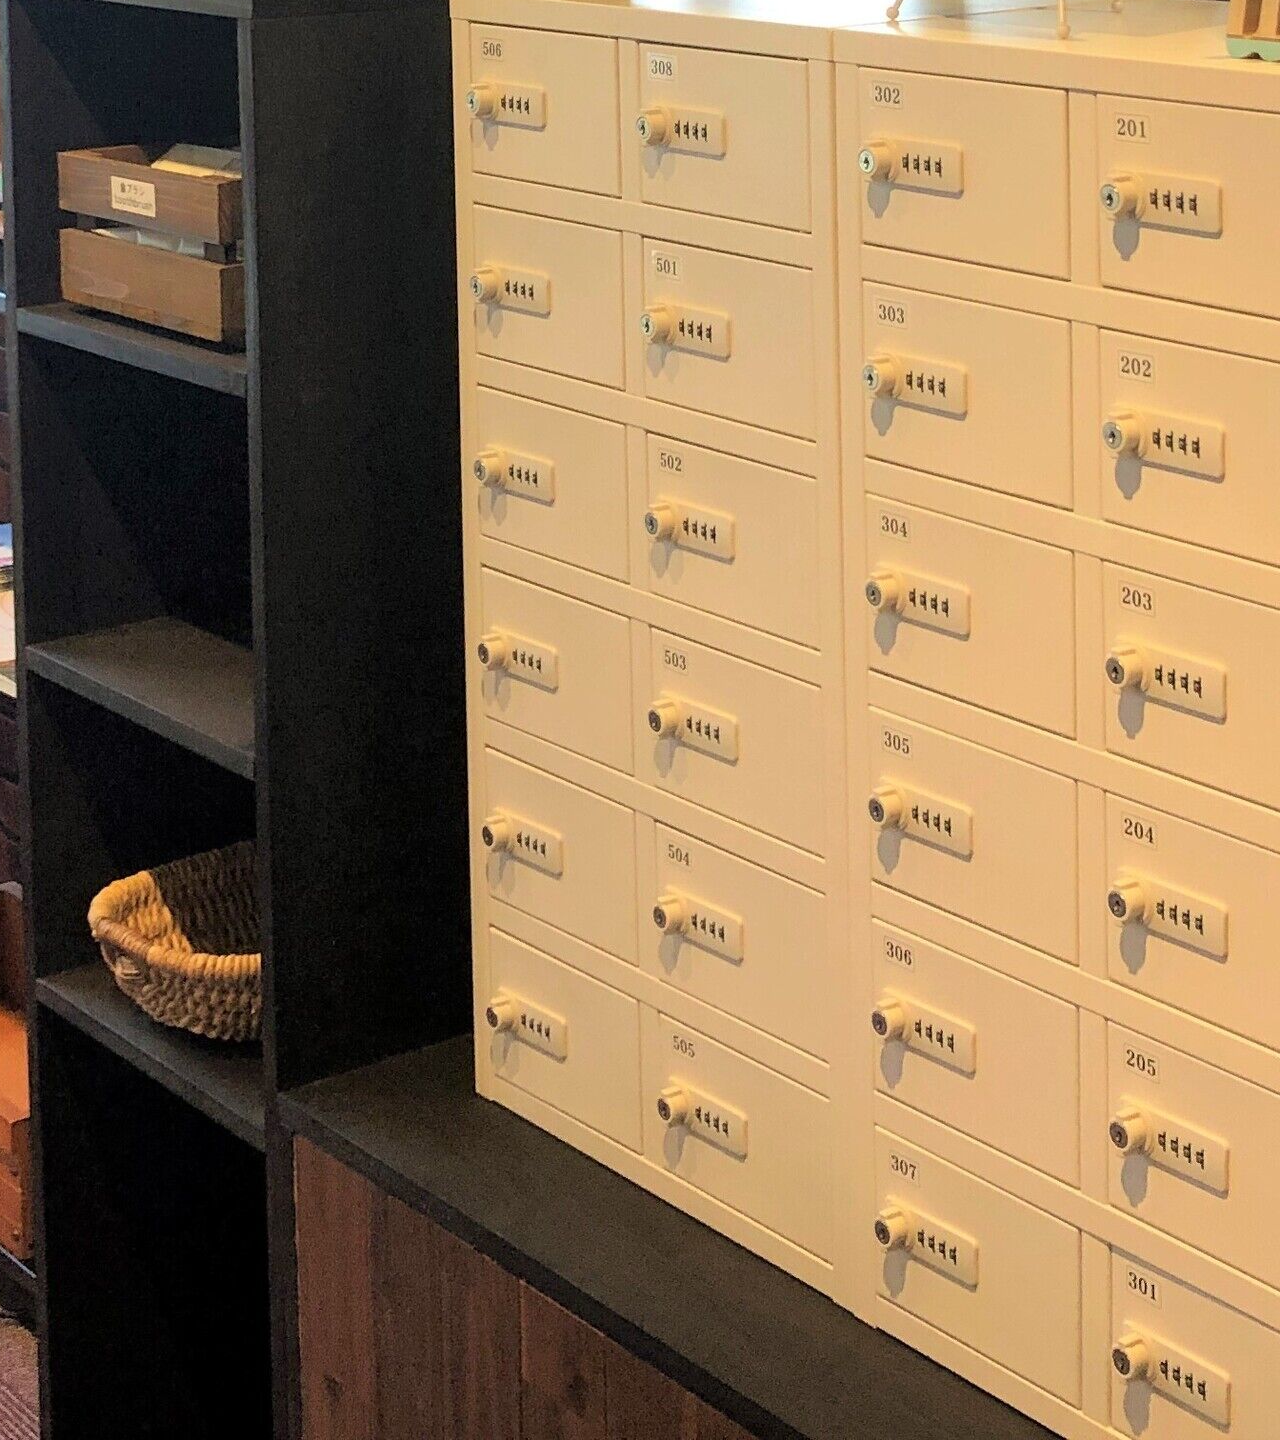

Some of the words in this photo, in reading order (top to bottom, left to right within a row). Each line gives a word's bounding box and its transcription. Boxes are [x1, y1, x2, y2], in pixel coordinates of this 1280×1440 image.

[482, 41, 502, 57] 506
[652, 60, 673, 76] 308
[875, 86, 900, 105] 302
[1116, 118, 1146, 138] 201
[656, 257, 677, 276] 501
[879, 305, 905, 324] 303
[1121, 356, 1152, 378] 202
[660, 452, 682, 472] 502
[881, 517, 908, 538] 304
[1122, 587, 1152, 611] 203
[664, 651, 687, 671] 503
[883, 732, 910, 754] 305
[1124, 819, 1153, 844] 204
[668, 843, 690, 866] 504
[886, 942, 912, 966] 306
[672, 1035, 696, 1058] 505
[1126, 1050, 1156, 1077] 205
[891, 1156, 917, 1180] 307
[1128, 1271, 1156, 1301] 301
